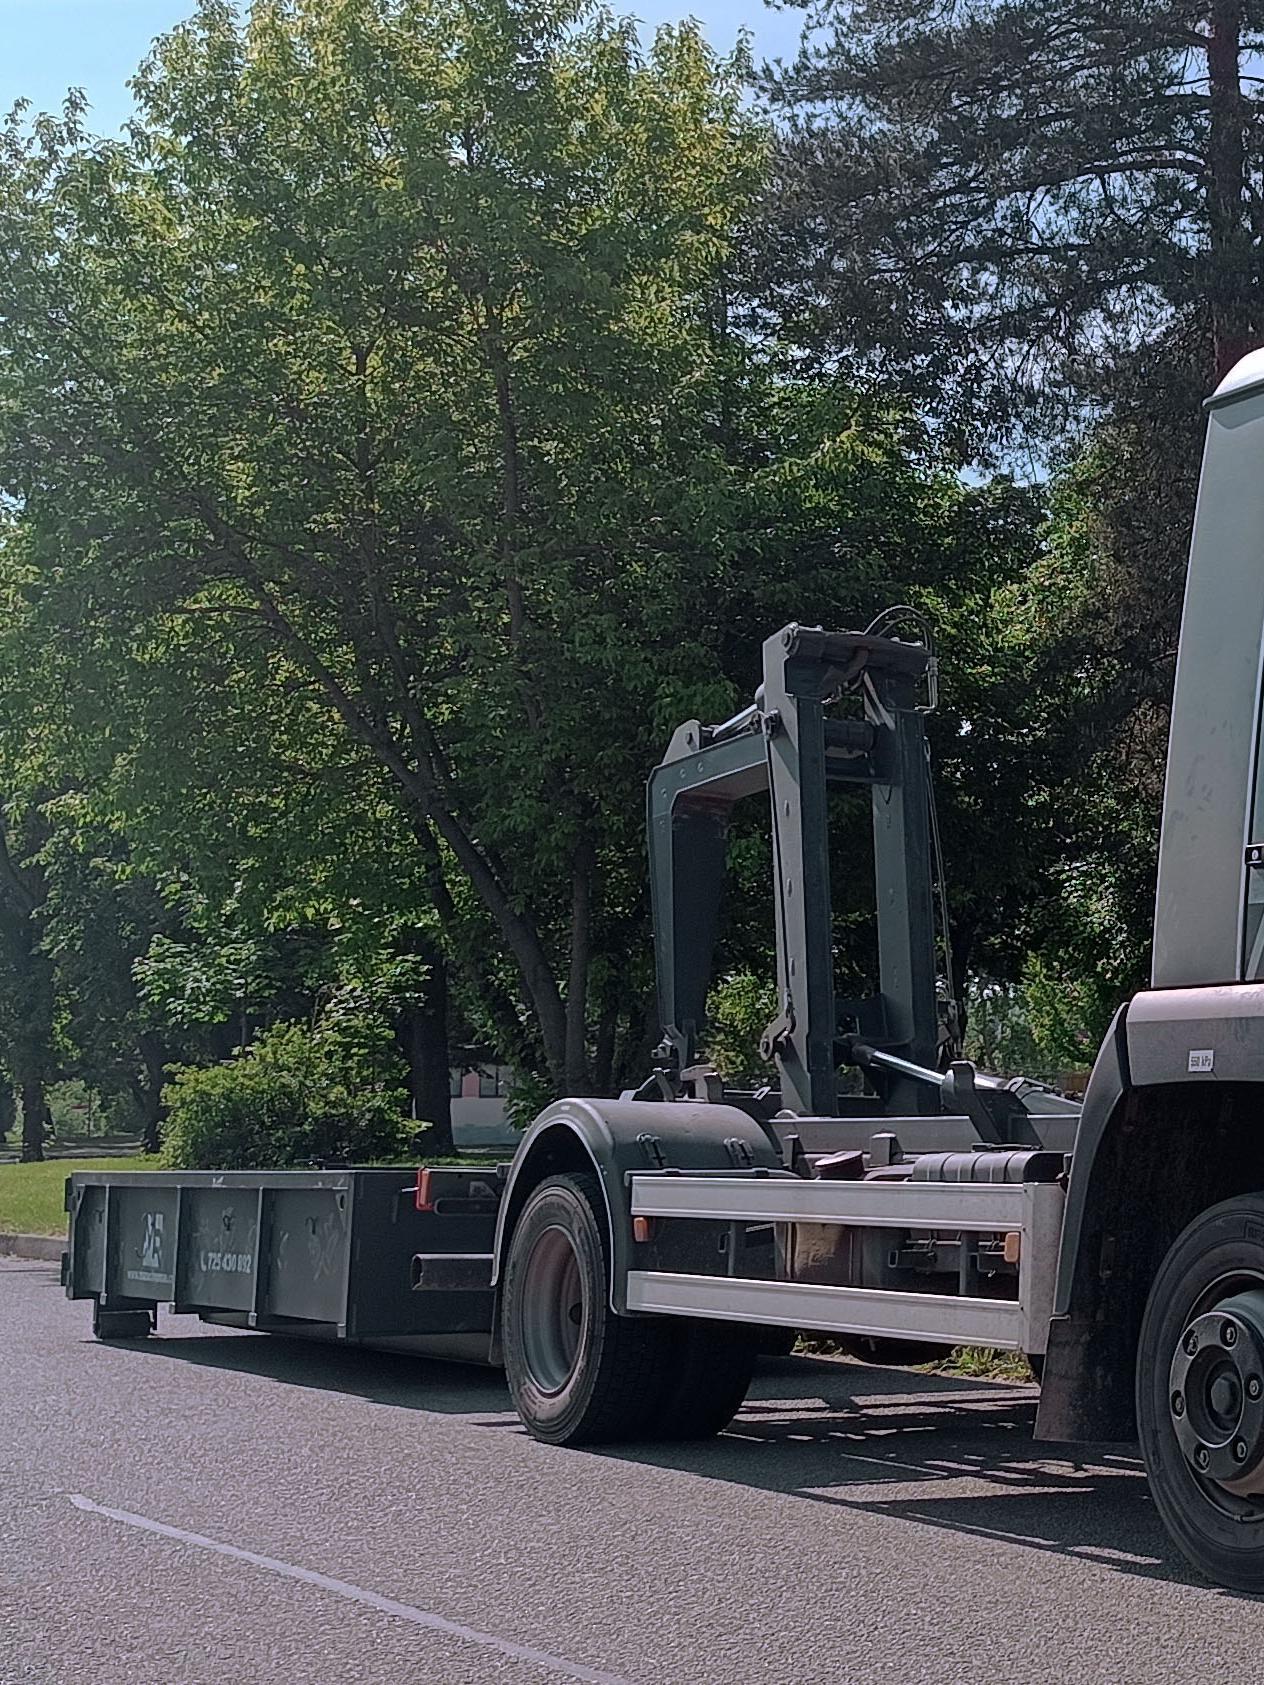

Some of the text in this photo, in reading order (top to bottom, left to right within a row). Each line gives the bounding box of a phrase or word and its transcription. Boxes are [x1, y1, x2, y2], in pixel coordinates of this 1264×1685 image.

[208, 1252, 252, 1273] 725 430 892
